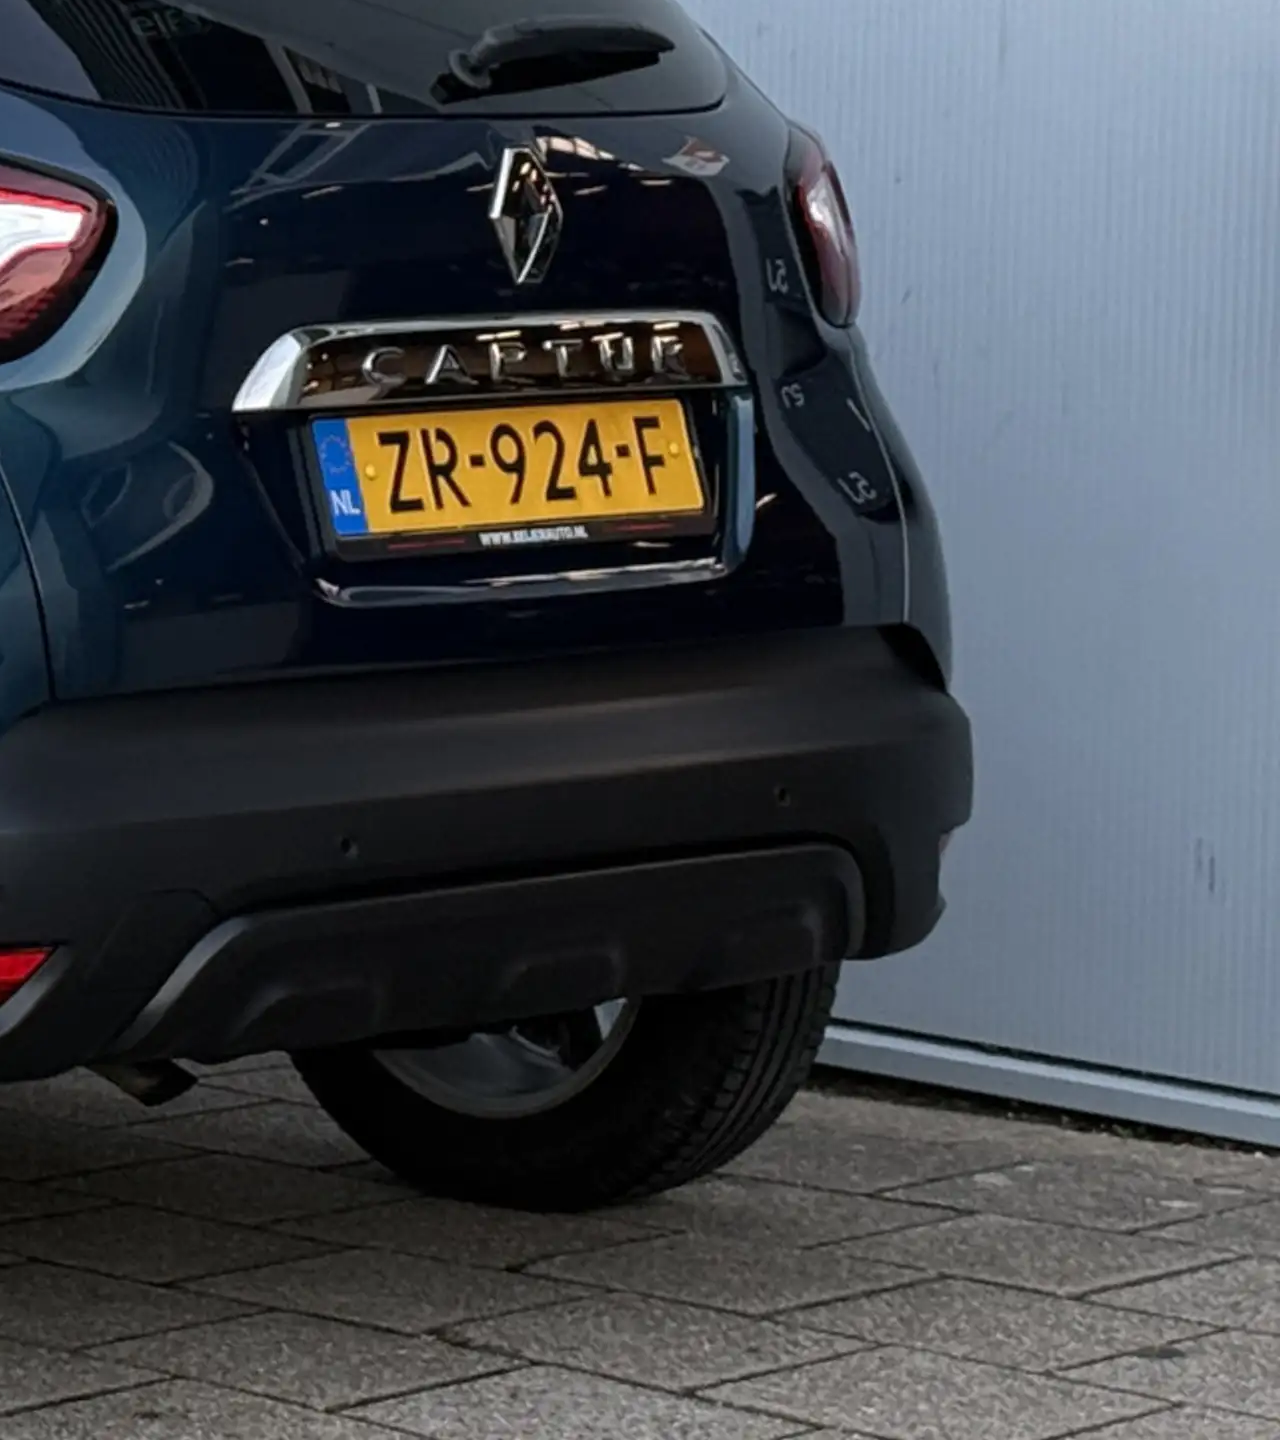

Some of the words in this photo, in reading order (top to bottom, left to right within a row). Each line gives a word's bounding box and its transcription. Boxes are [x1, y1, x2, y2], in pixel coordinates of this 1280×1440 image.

[361, 334, 690, 386] CAPTUR
[377, 415, 666, 514] ZR-924-F
[330, 490, 361, 516] NL
